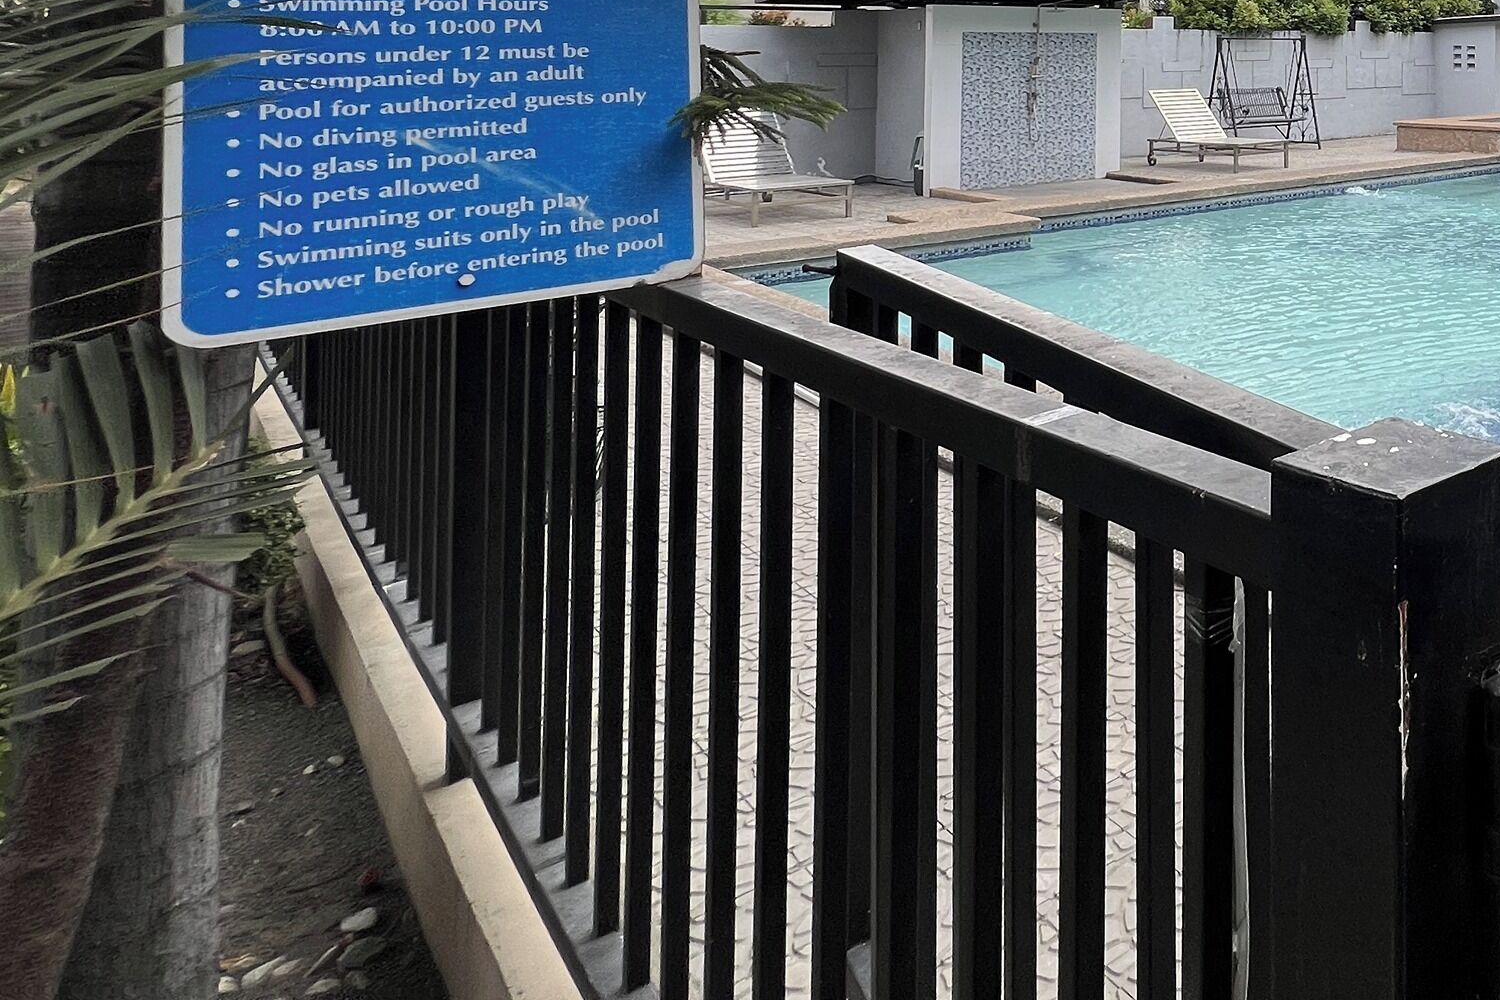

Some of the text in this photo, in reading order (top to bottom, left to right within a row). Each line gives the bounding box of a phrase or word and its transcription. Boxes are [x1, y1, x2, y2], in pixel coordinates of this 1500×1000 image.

[389, 20, 416, 36] to
[426, 18, 496, 36] 10:00
[504, 18, 543, 35] PM
[258, 42, 590, 67] Persons under 12 must be
[259, 64, 584, 93] accompanied by an adult
[259, 87, 648, 121] Pool for authorized guests only
[259, 117, 527, 150] No diving permitted
[259, 147, 537, 181] No glass in pool area
[259, 173, 479, 210] No pets allowed
[259, 192, 590, 239] No running or rough play
[257, 208, 659, 270] Swimming suits only in the pool
[257, 232, 664, 299] Shower before entering the pool
